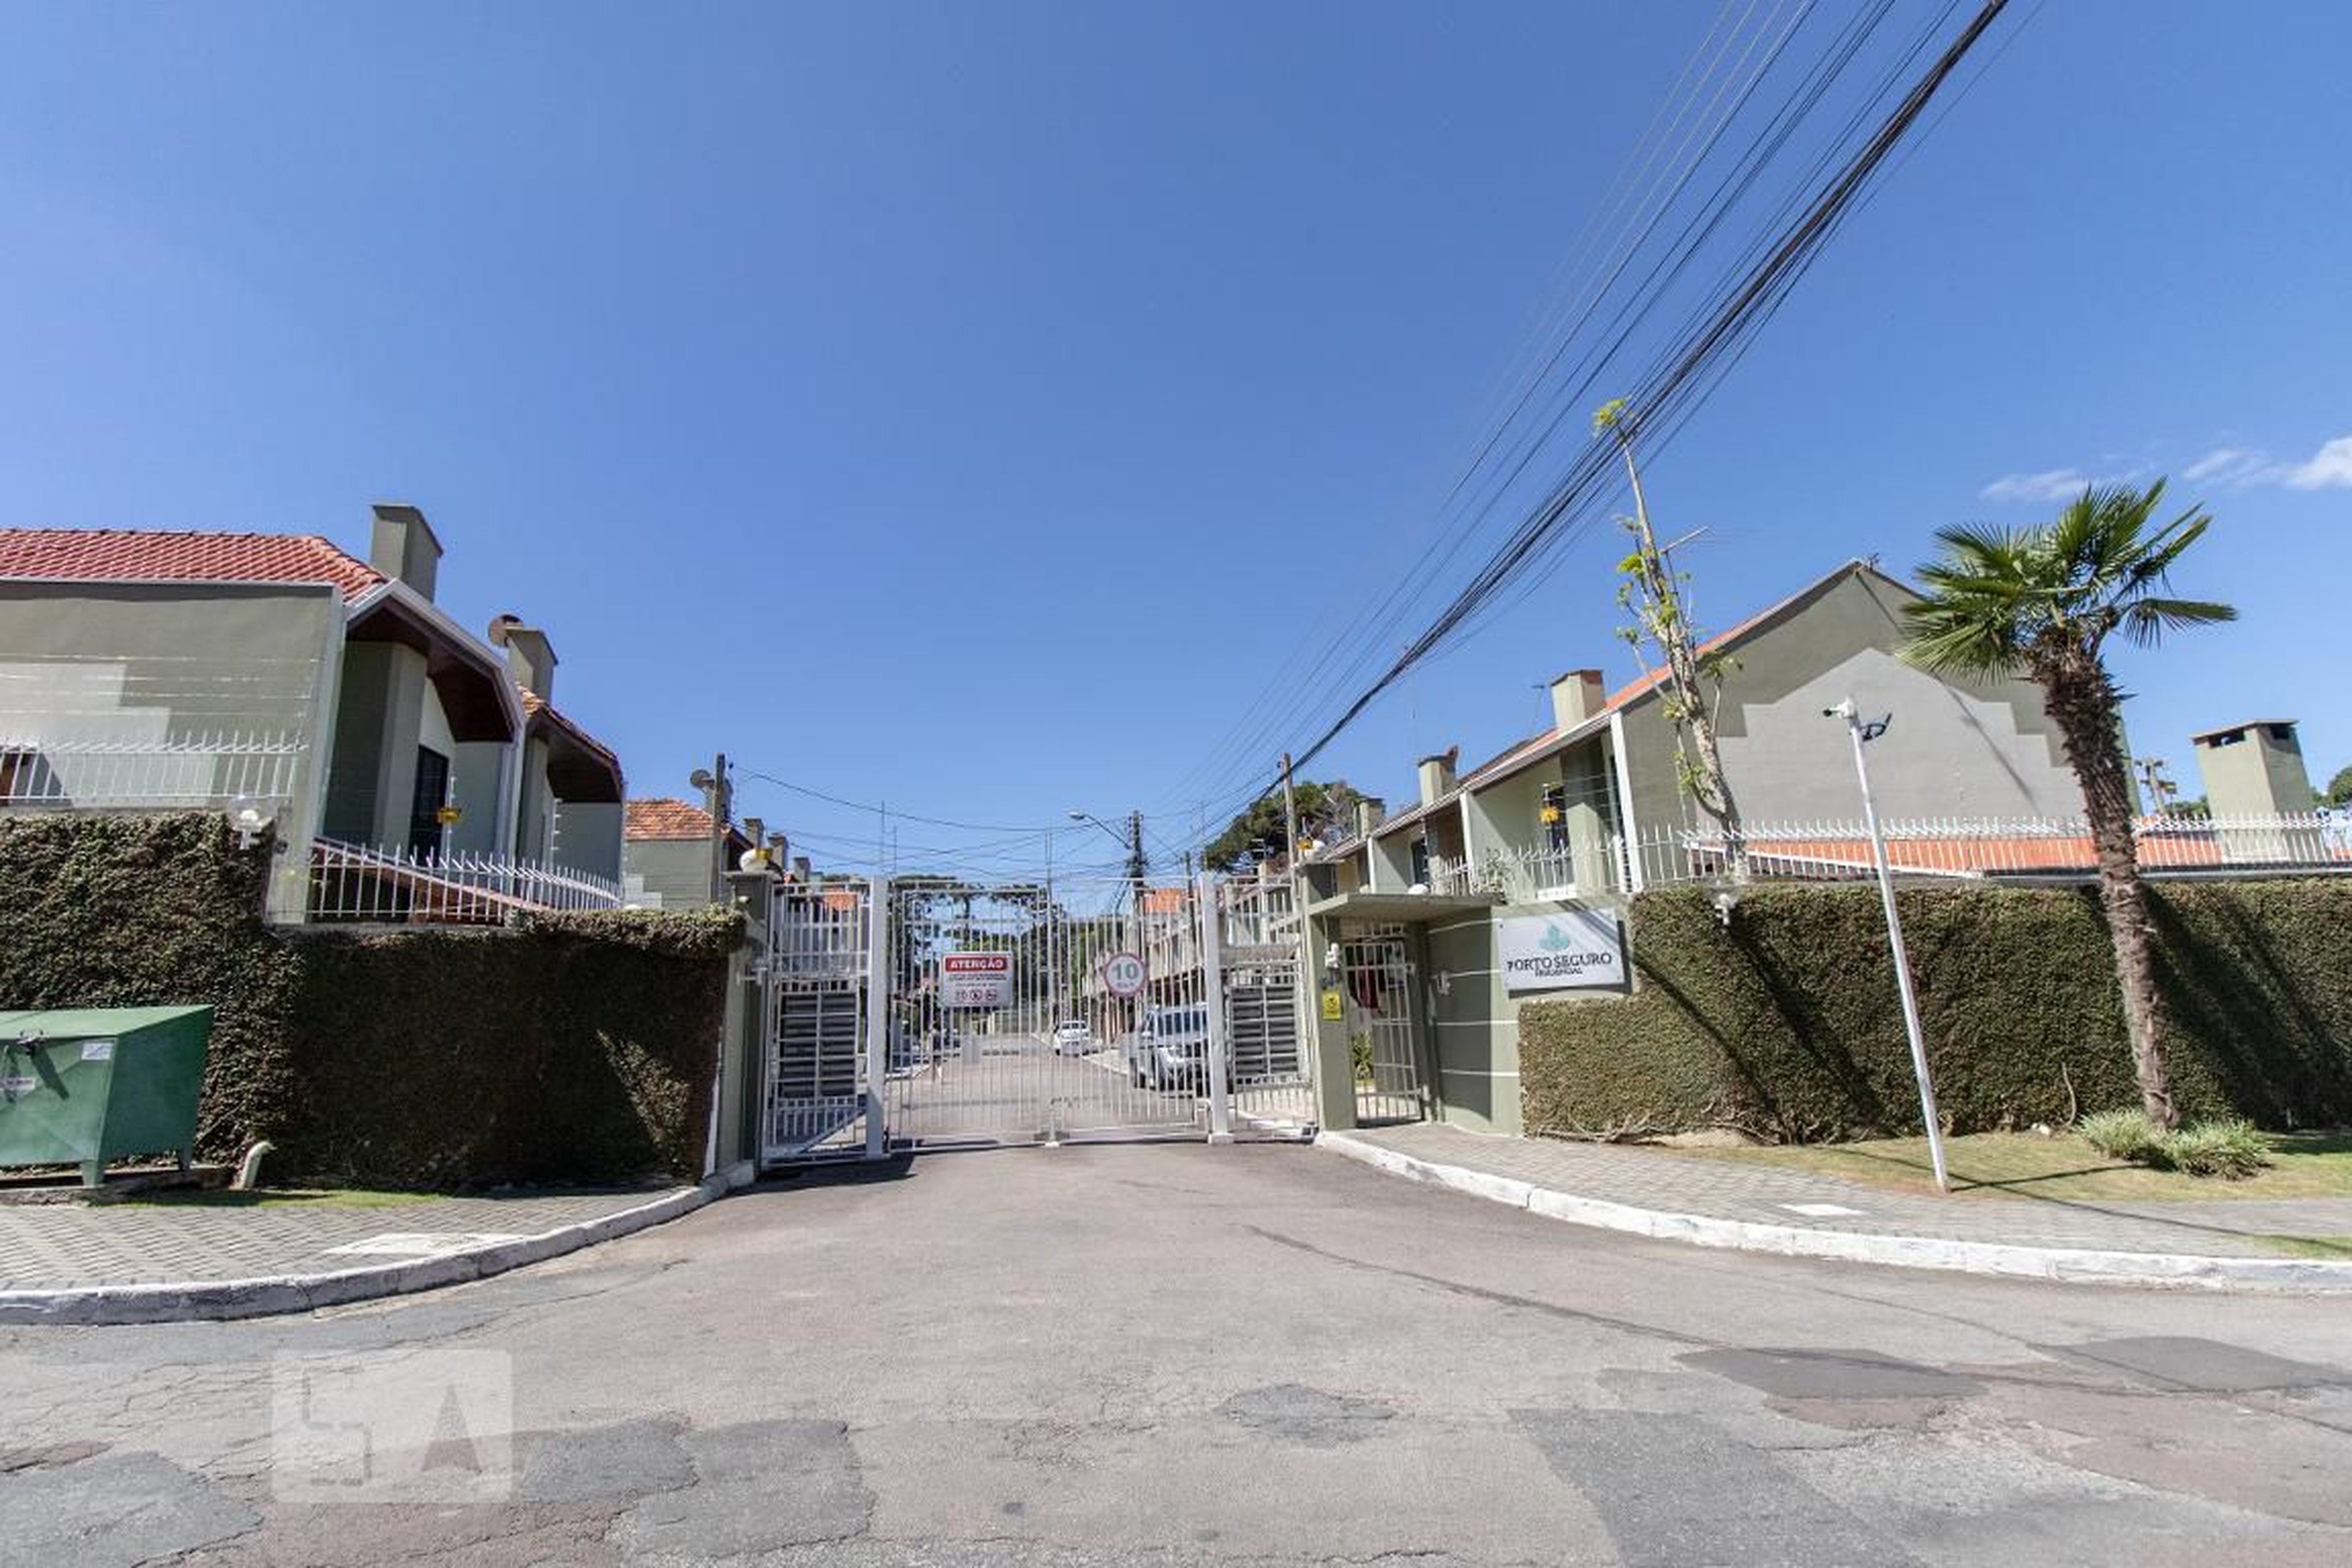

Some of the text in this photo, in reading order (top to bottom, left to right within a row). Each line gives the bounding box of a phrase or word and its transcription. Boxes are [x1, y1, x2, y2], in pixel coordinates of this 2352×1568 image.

[950, 957, 1005, 969] ATENÇÃO
[1553, 951, 1612, 968] SEGURO
[1112, 963, 1139, 979] 10
